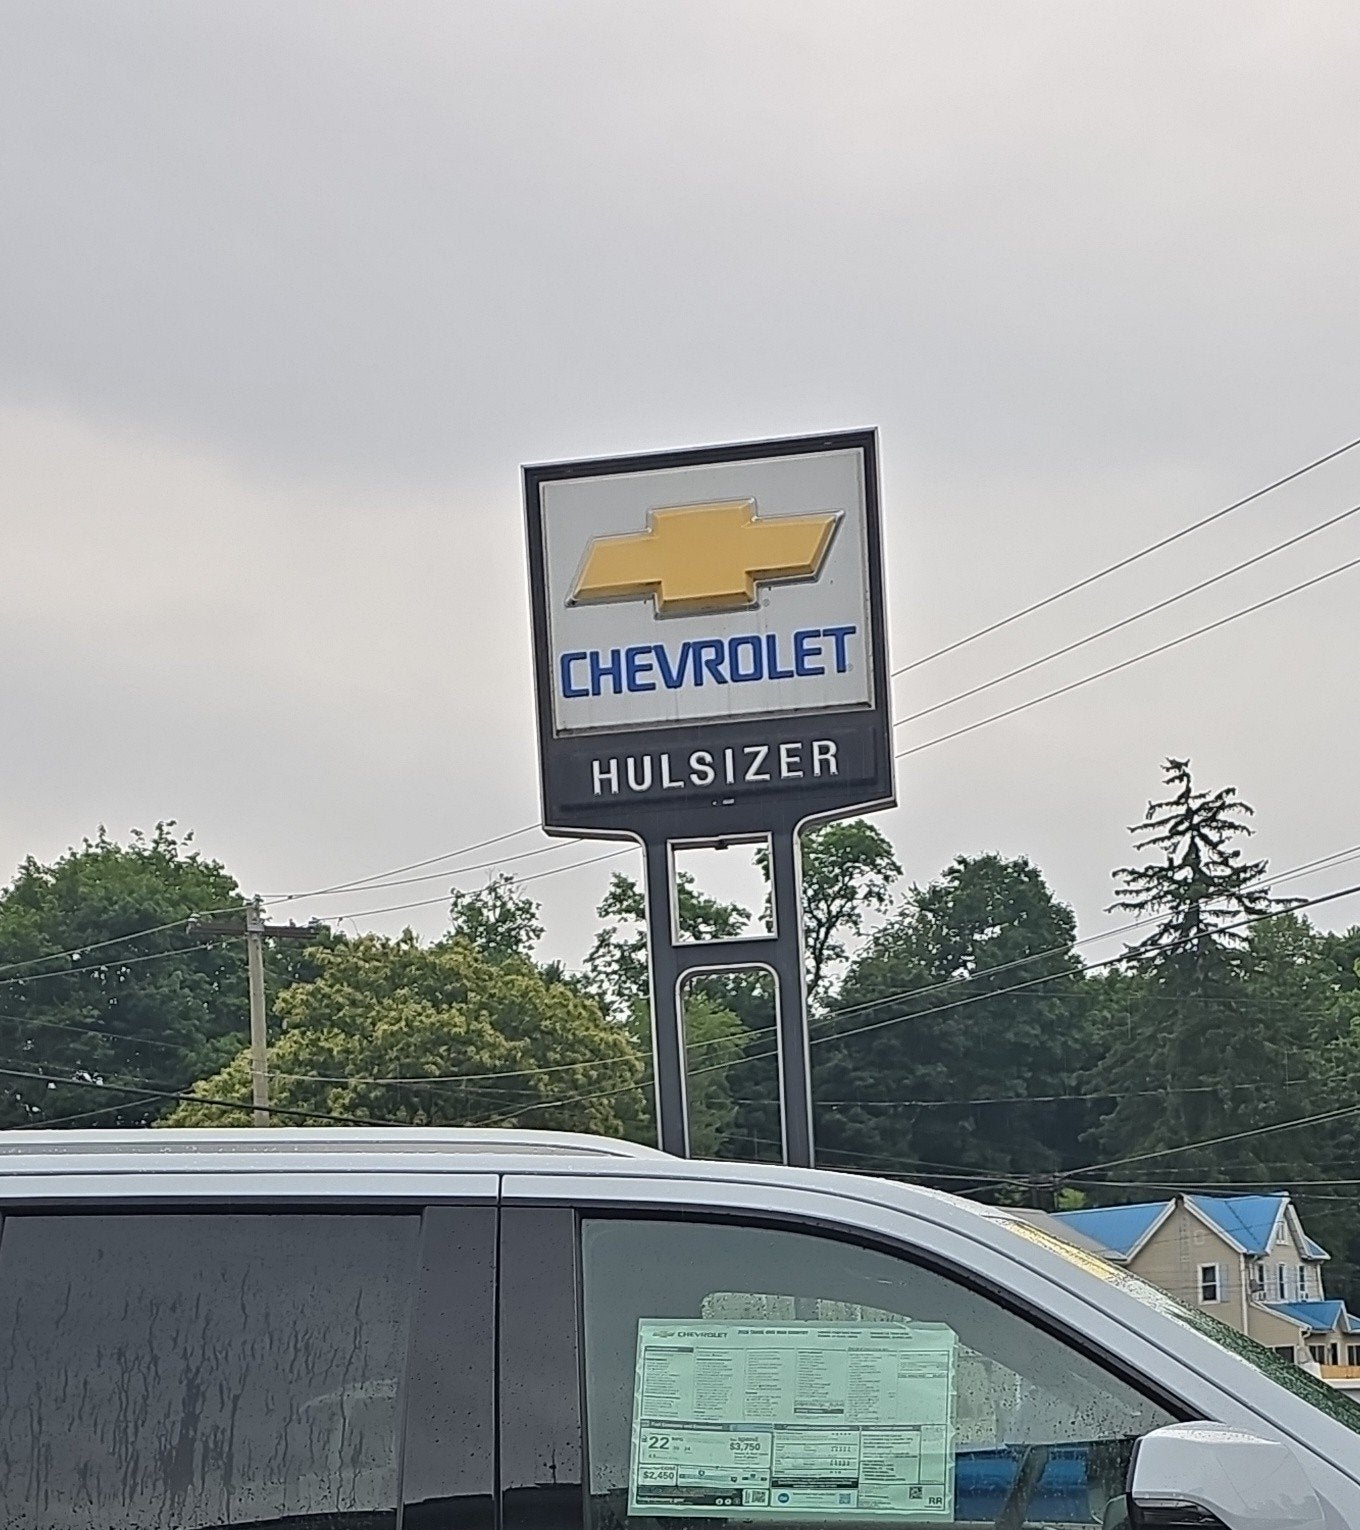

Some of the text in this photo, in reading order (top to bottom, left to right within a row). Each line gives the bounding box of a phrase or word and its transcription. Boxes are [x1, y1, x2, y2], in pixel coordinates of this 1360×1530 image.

[559, 625, 857, 699] CHEVROLET
[592, 739, 839, 796] HULSIZER
[648, 1436, 669, 1449] 22
[729, 1442, 761, 1451] $3,750
[643, 1471, 675, 1480] $2,450
